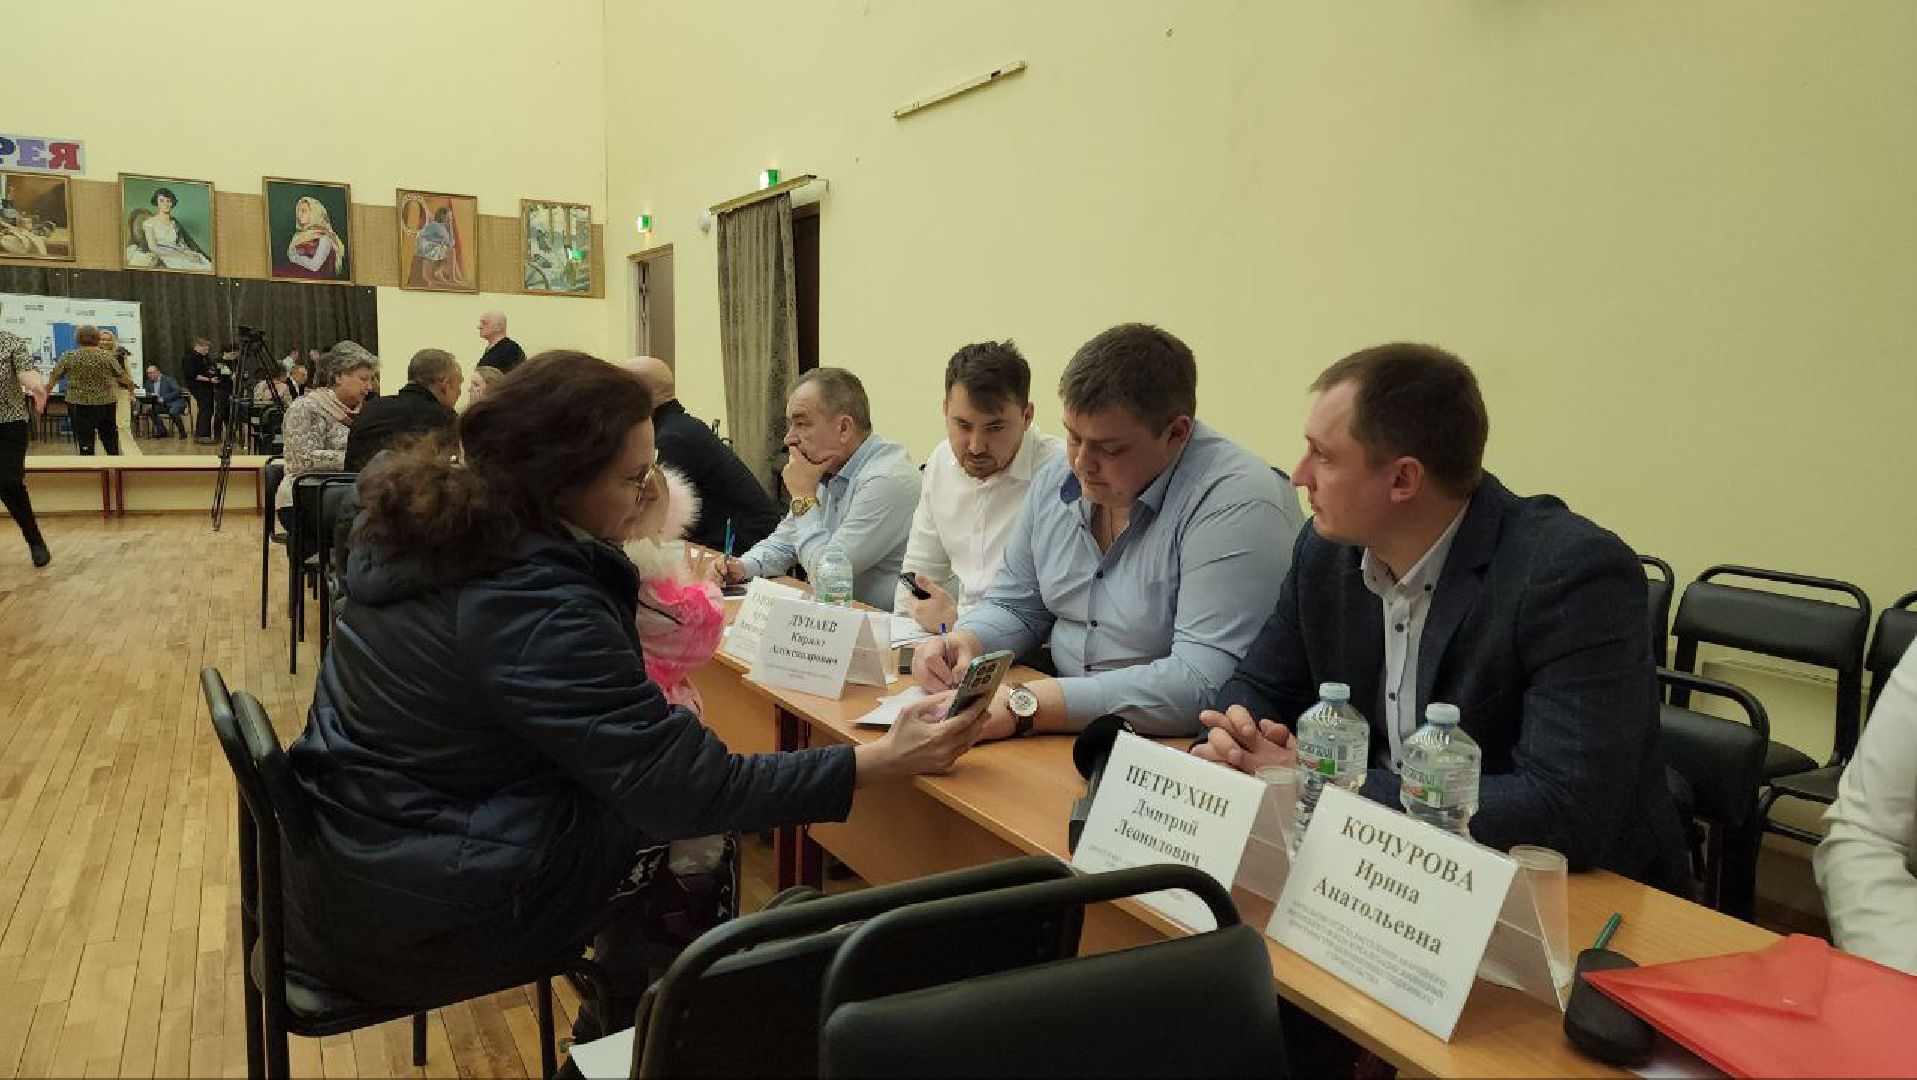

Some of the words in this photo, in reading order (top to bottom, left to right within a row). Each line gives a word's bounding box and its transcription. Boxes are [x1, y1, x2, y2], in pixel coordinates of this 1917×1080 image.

[1126, 765, 1229, 818] ПЕТРУХИН
[1132, 798, 1199, 836] Дмитрий
[1340, 815, 1474, 893] КОЧУРОВА
[1355, 857, 1421, 904] Ирина
[1313, 876, 1442, 955] Анатольевна
